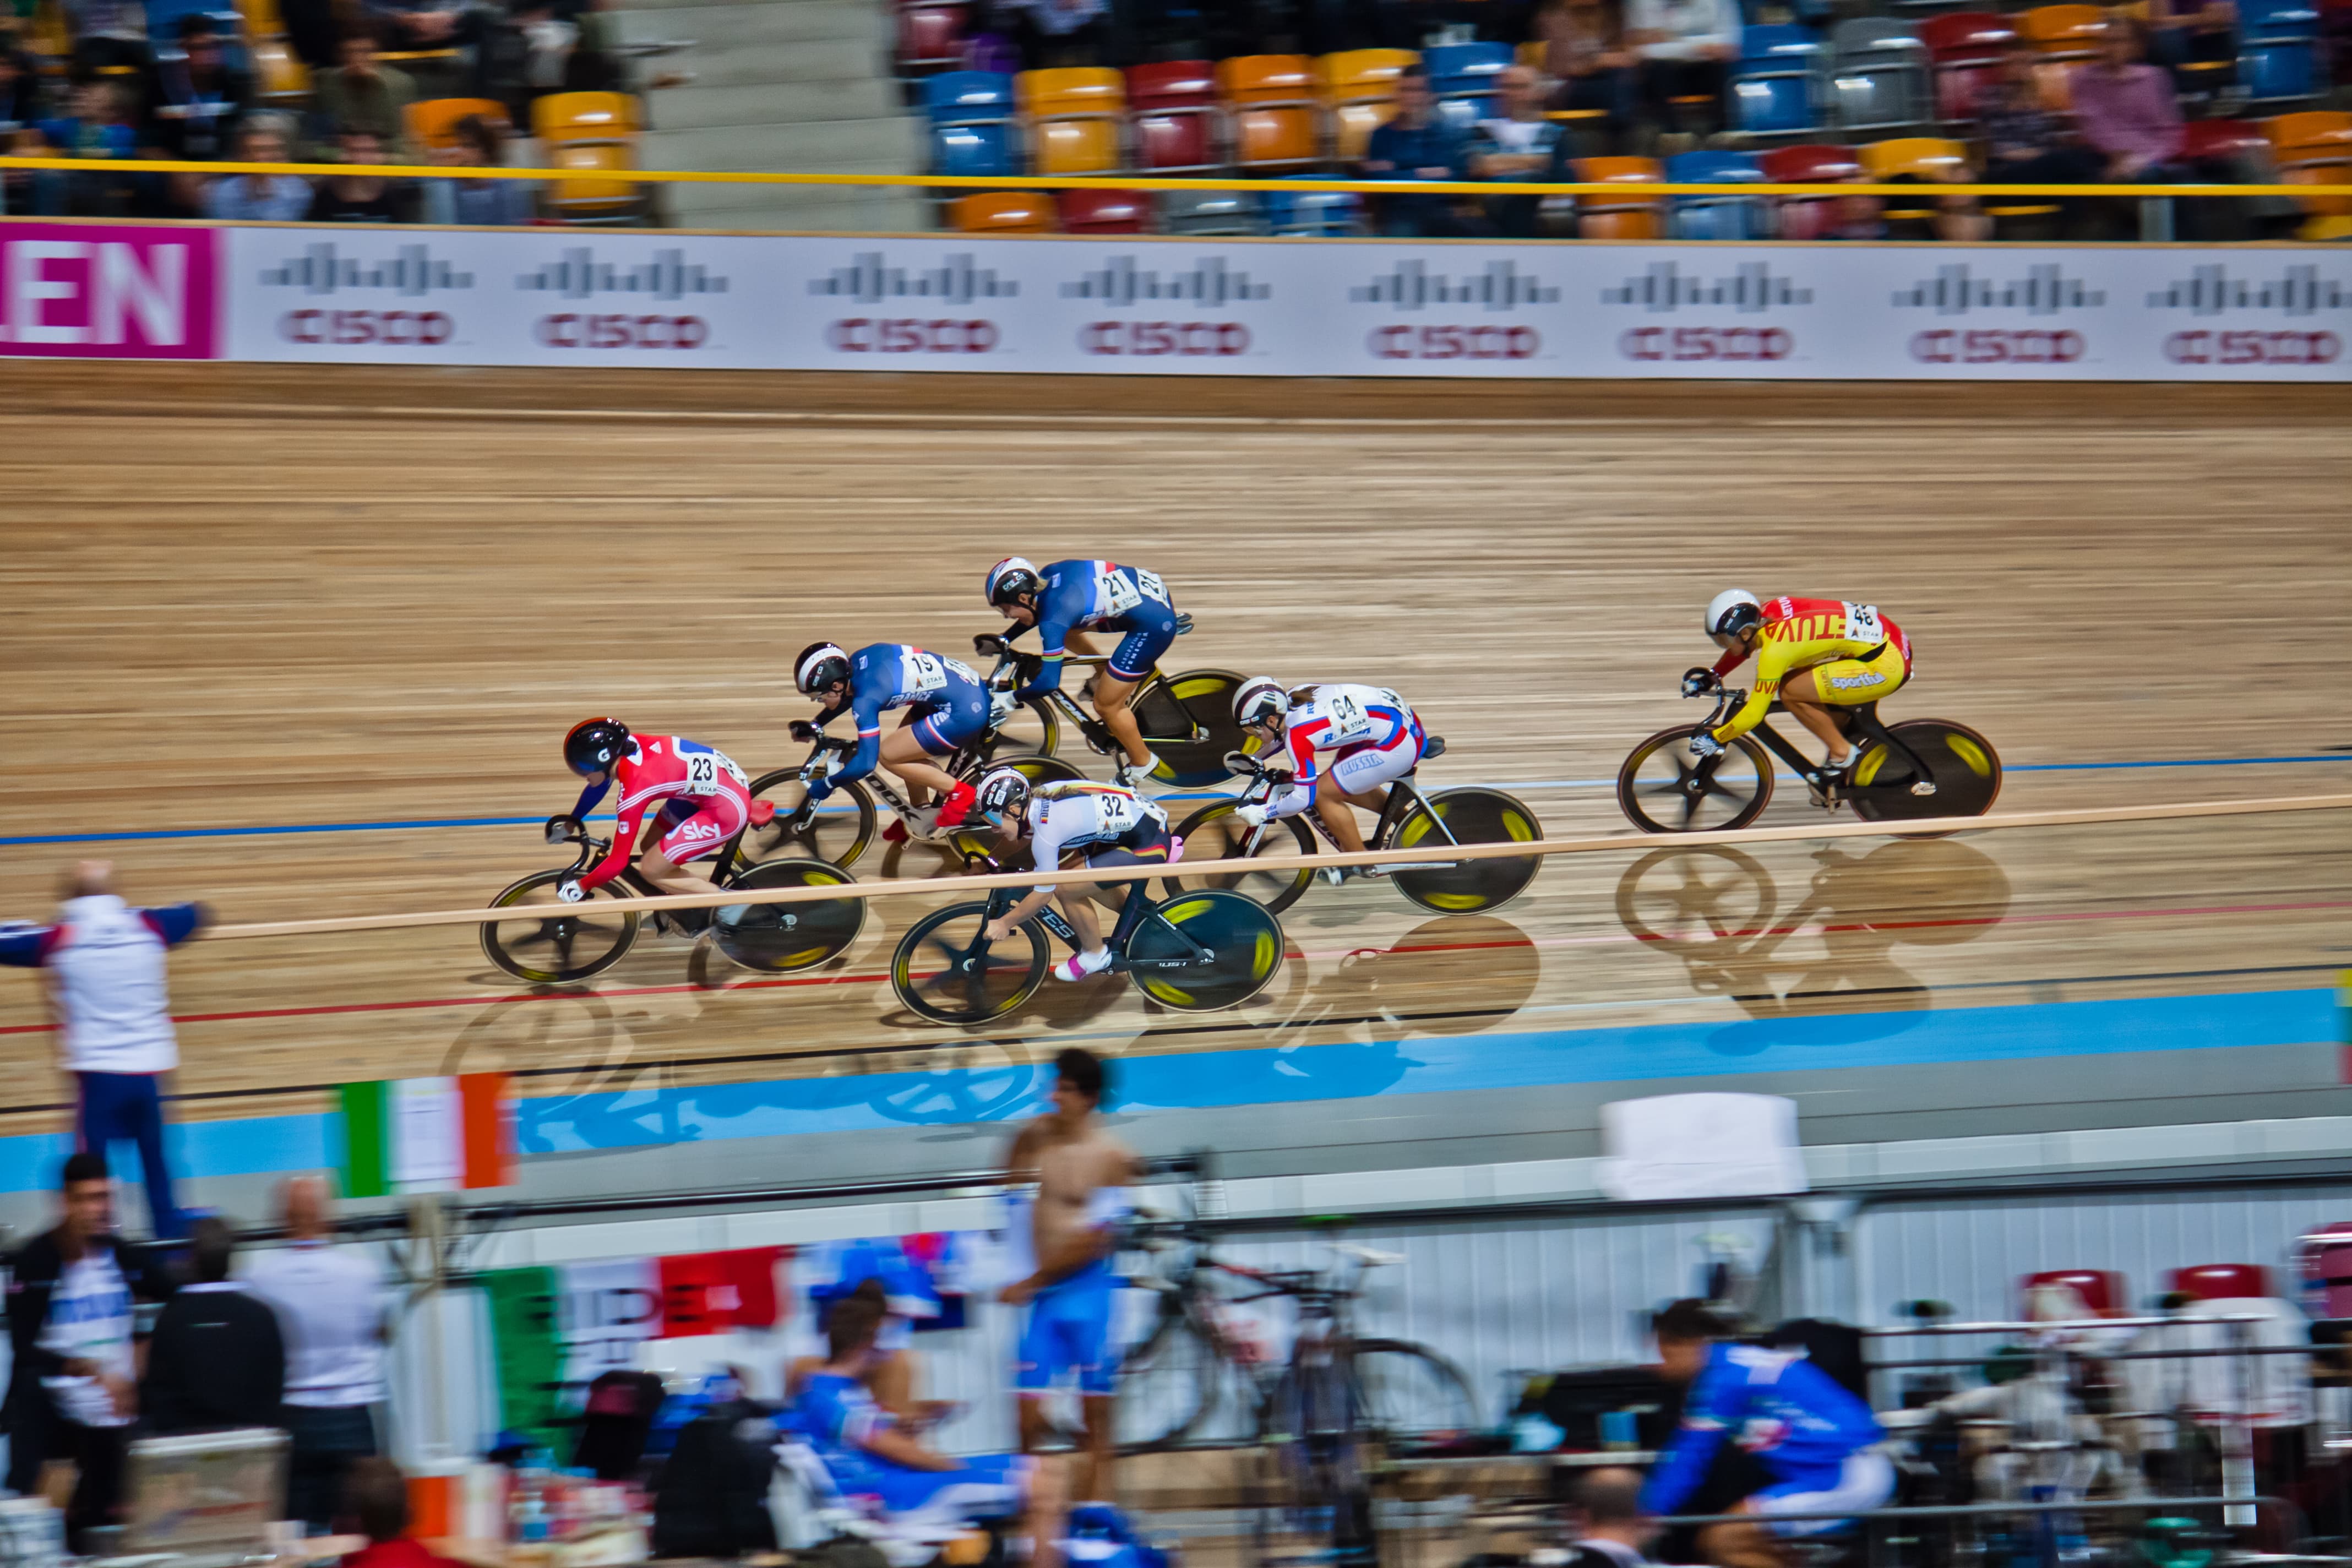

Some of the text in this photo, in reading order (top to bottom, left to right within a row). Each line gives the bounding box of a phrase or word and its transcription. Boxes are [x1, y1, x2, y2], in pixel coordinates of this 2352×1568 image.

[0, 240, 188, 346] EN
[279, 309, 454, 345] CISCO
[536, 313, 710, 349] CISCO
[826, 318, 1000, 352] CISCO
[1079, 322, 1251, 356] CISCO
[1368, 325, 1538, 359] CISCO
[1620, 327, 1792, 361] CISCO
[1910, 329, 2084, 363] CISCO
[2165, 330, 2340, 364] CISCO
[1102, 574, 1126, 597] 21
[911, 655, 933, 674] 19
[886, 691, 934, 707] FRANCE
[1332, 695, 1357, 720] 64
[1351, 718, 1366, 728] STAR
[693, 758, 712, 781] 23
[1341, 753, 1384, 776] RUSSIA
[865, 775, 921, 823] OOK
[1102, 796, 1124, 817] 32
[683, 821, 721, 840] sky
